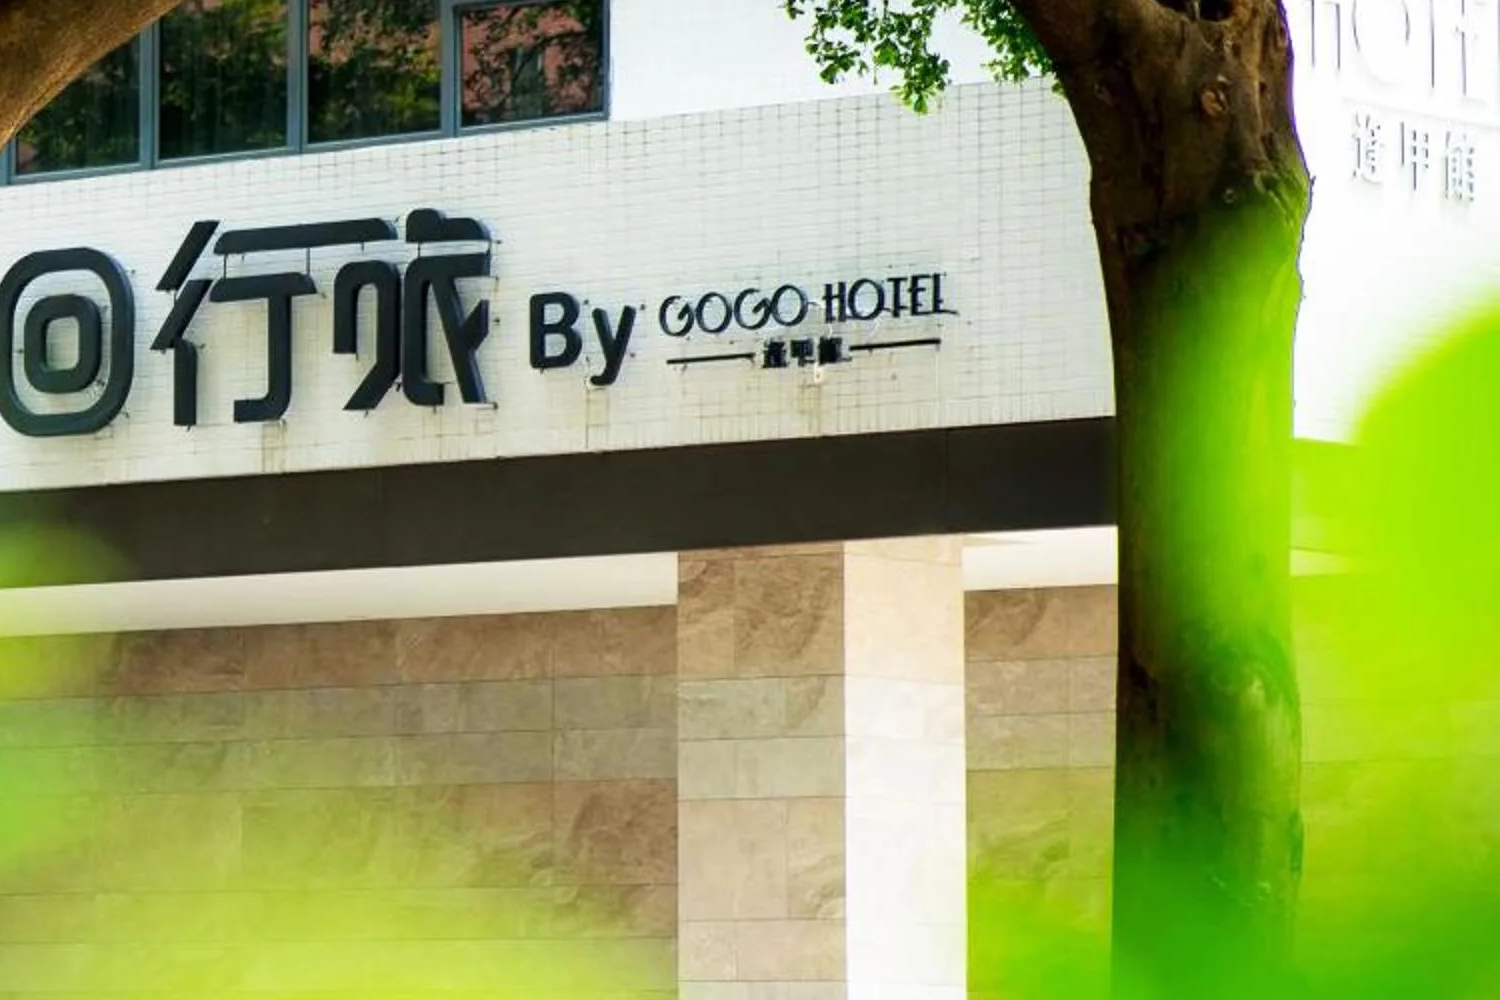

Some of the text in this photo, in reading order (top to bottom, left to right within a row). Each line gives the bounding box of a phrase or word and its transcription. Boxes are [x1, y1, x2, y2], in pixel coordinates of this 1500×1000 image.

[529, 291, 637, 386] By
[659, 284, 809, 337] GOGO
[822, 272, 950, 325] HOTEL
